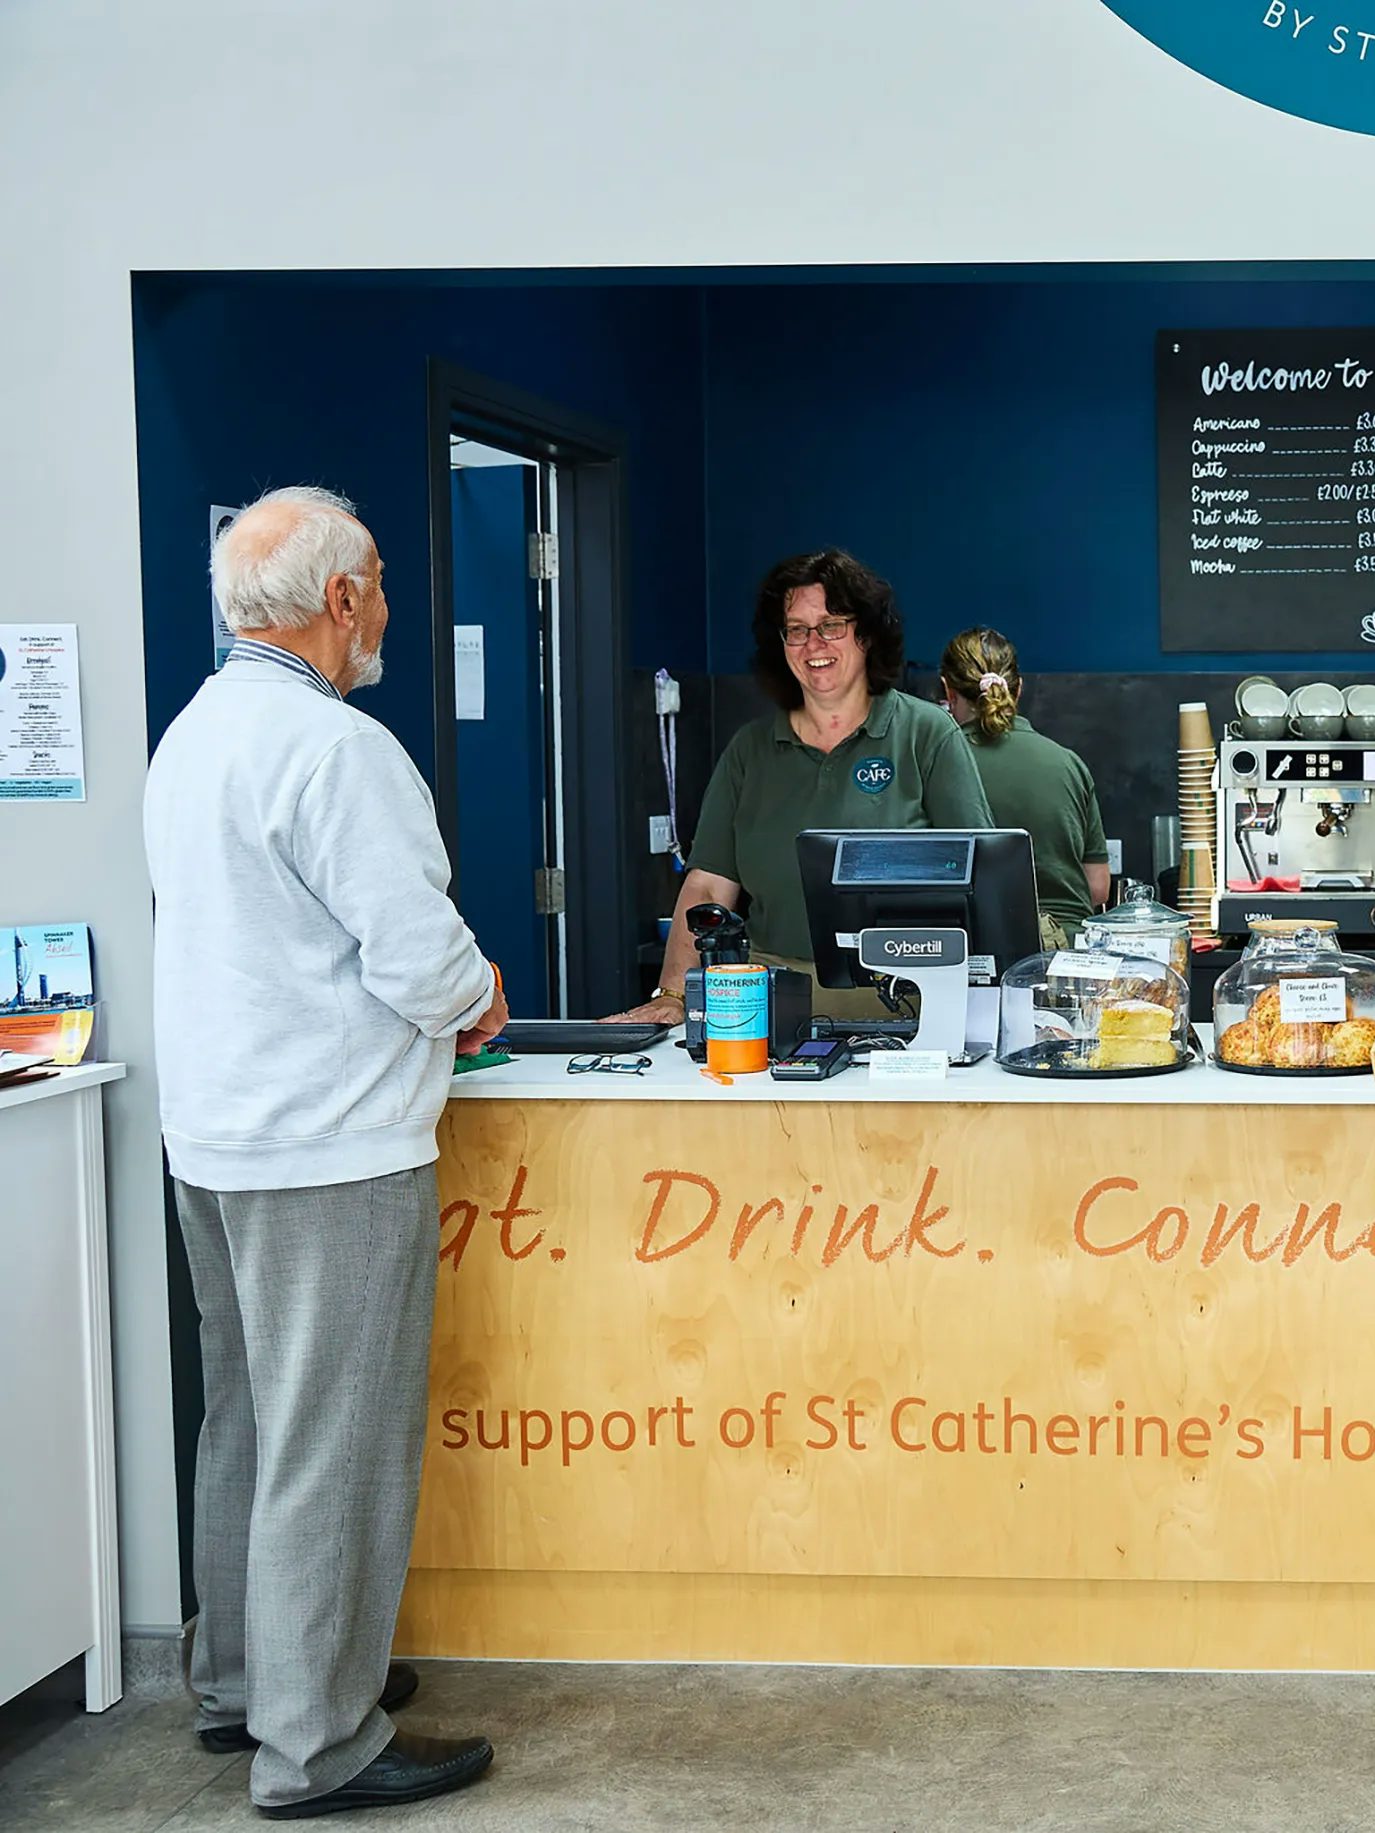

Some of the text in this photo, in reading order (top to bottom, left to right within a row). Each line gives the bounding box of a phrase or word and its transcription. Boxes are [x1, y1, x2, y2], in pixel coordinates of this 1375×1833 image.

[1263, 0, 1314, 38] BY
[1201, 360, 1332, 396] Welcome
[1334, 357, 1374, 389] to
[1193, 416, 1261, 433] Americano
[1191, 439, 1266, 459] Cappuccino
[1191, 461, 1228, 479] Latte
[1191, 508, 1222, 526] Flat
[1223, 508, 1263, 526] white
[1190, 533, 1222, 551] Iced
[1222, 535, 1264, 554] coffee
[1189, 558, 1237, 575] Mocha
[884, 940, 943, 957] Cybertill
[438, 1164, 568, 1273] at.
[634, 1166, 995, 1265] Drink.
[441, 1395, 695, 1466] support
[720, 1392, 785, 1450] of
[806, 1395, 865, 1452] St
[890, 1396, 1265, 1460] Catherine's
